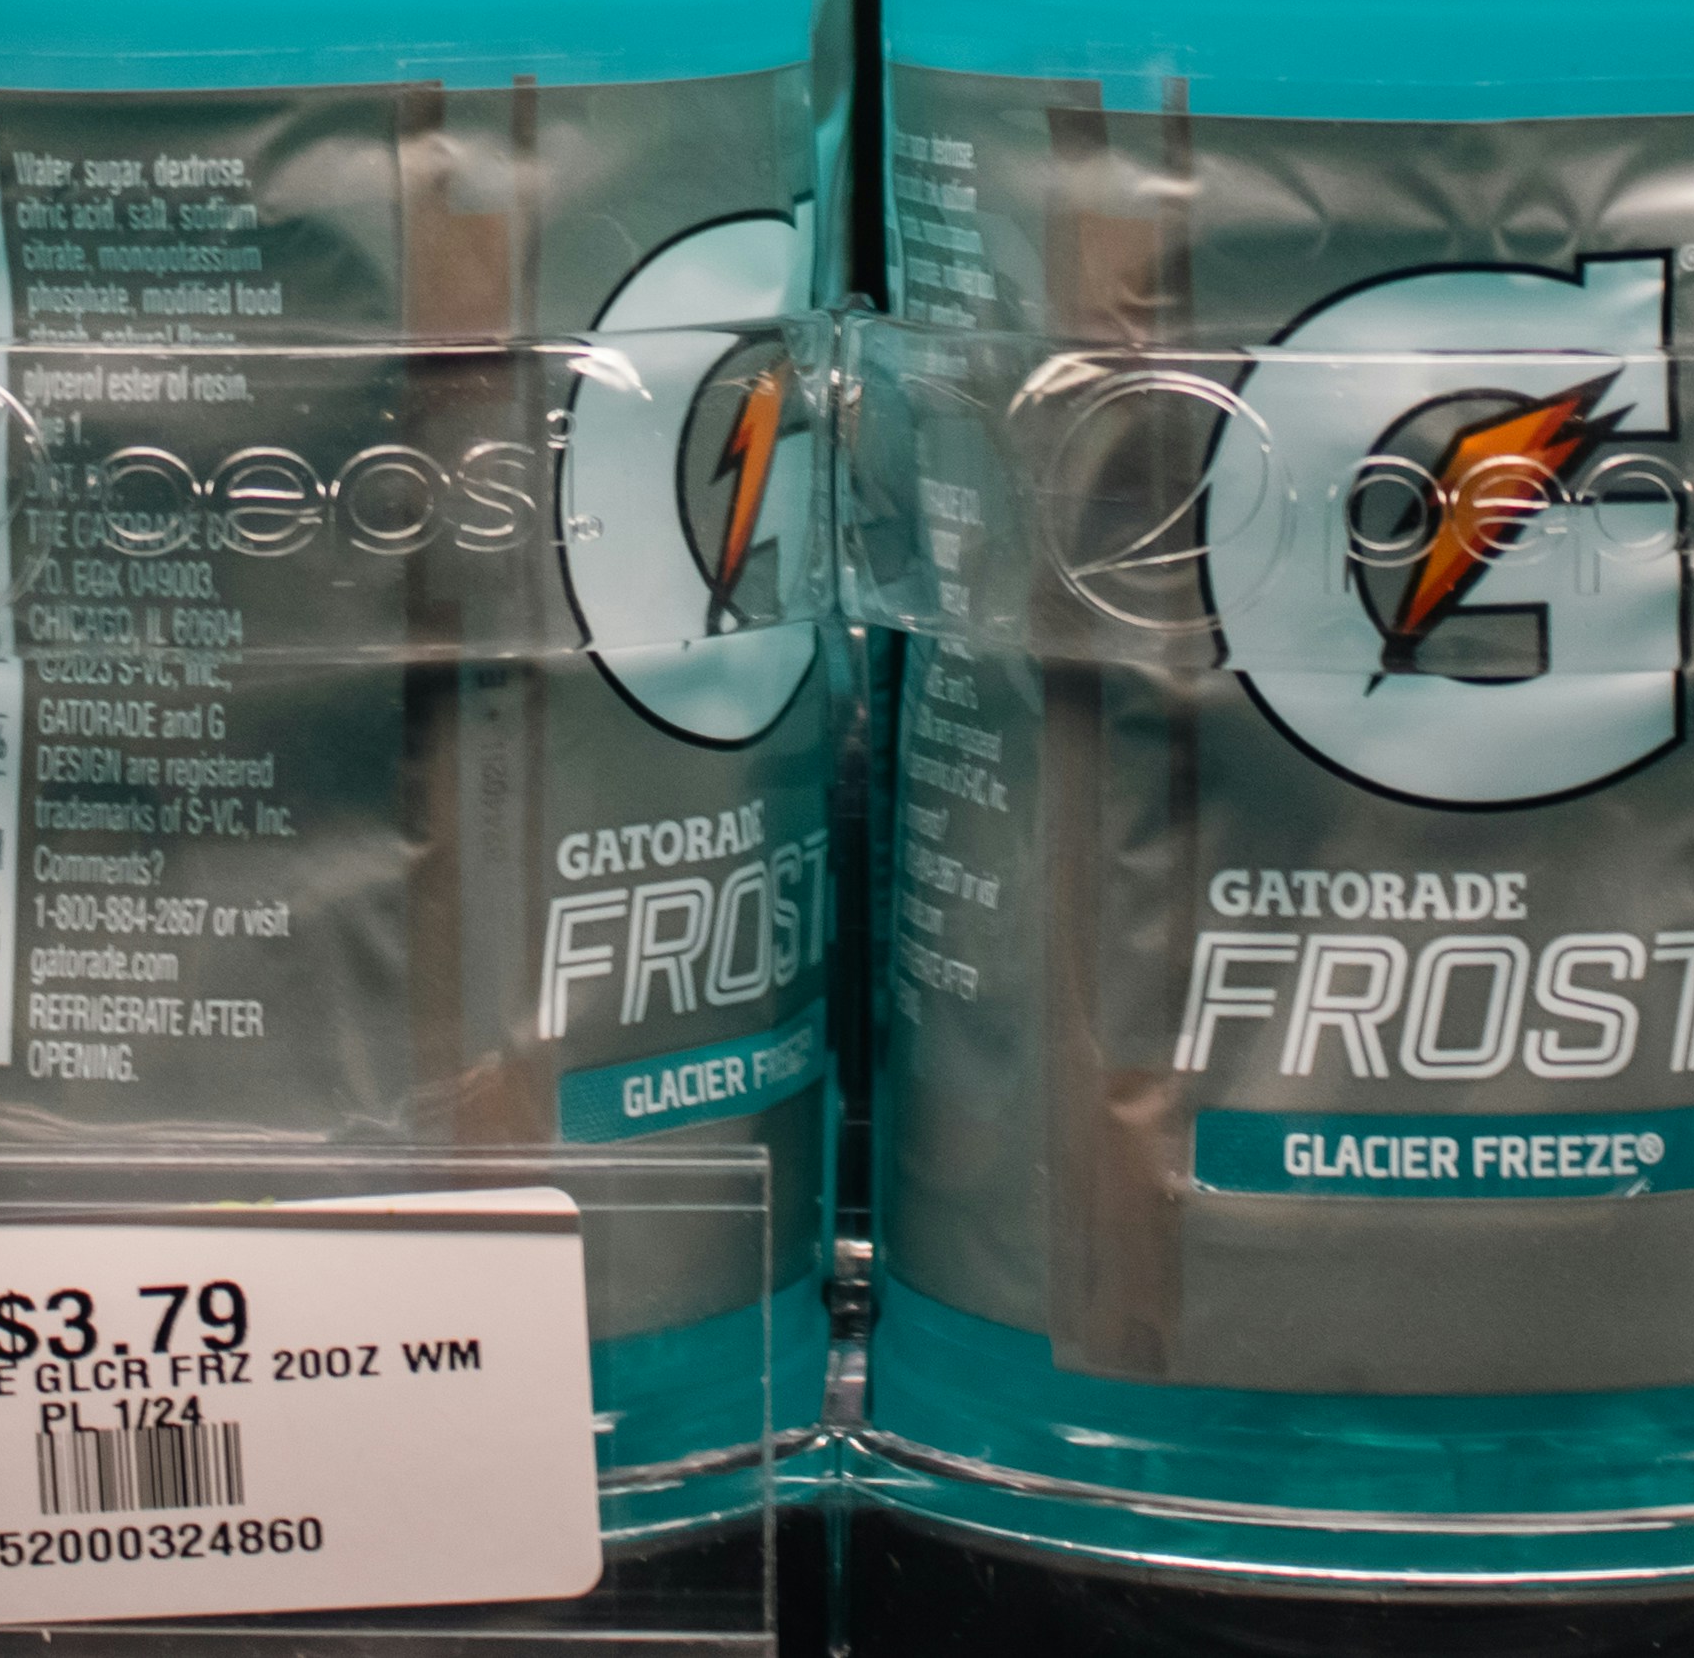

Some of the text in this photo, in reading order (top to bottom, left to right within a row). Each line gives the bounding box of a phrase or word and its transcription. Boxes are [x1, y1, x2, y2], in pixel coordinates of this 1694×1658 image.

[13, 151, 253, 195] Water, sugar, dextrose,
[16, 196, 259, 232] citric acid, salt, sodium
[23, 238, 264, 278] citrate, monopotassium
[27, 279, 137, 320] phosphate,
[143, 280, 232, 315] modified
[23, 364, 256, 406] glycerol ester of rosin,
[37, 697, 227, 739] GATORADE and G
[37, 744, 275, 793] DESIGN are registered
[34, 795, 298, 842] trademarks of S-VC, Inc.
[34, 844, 165, 887] Comments?
[1209, 868, 1529, 922] GATORADE
[212, 904, 240, 937] or
[243, 900, 292, 939] visit
[29, 944, 180, 986] gatorade.com
[28, 992, 265, 1038] REFRIGERATE AFTER
[27, 1040, 141, 1083] OPENING.
[622, 1055, 748, 1118] GLACIER
[1283, 1133, 1460, 1181] GLACIER
[35, 1356, 151, 1396] GLCR
[169, 1352, 253, 1388] FRZ
[402, 1339, 483, 1374] WM
[41, 1395, 204, 1436] PL 1/24
